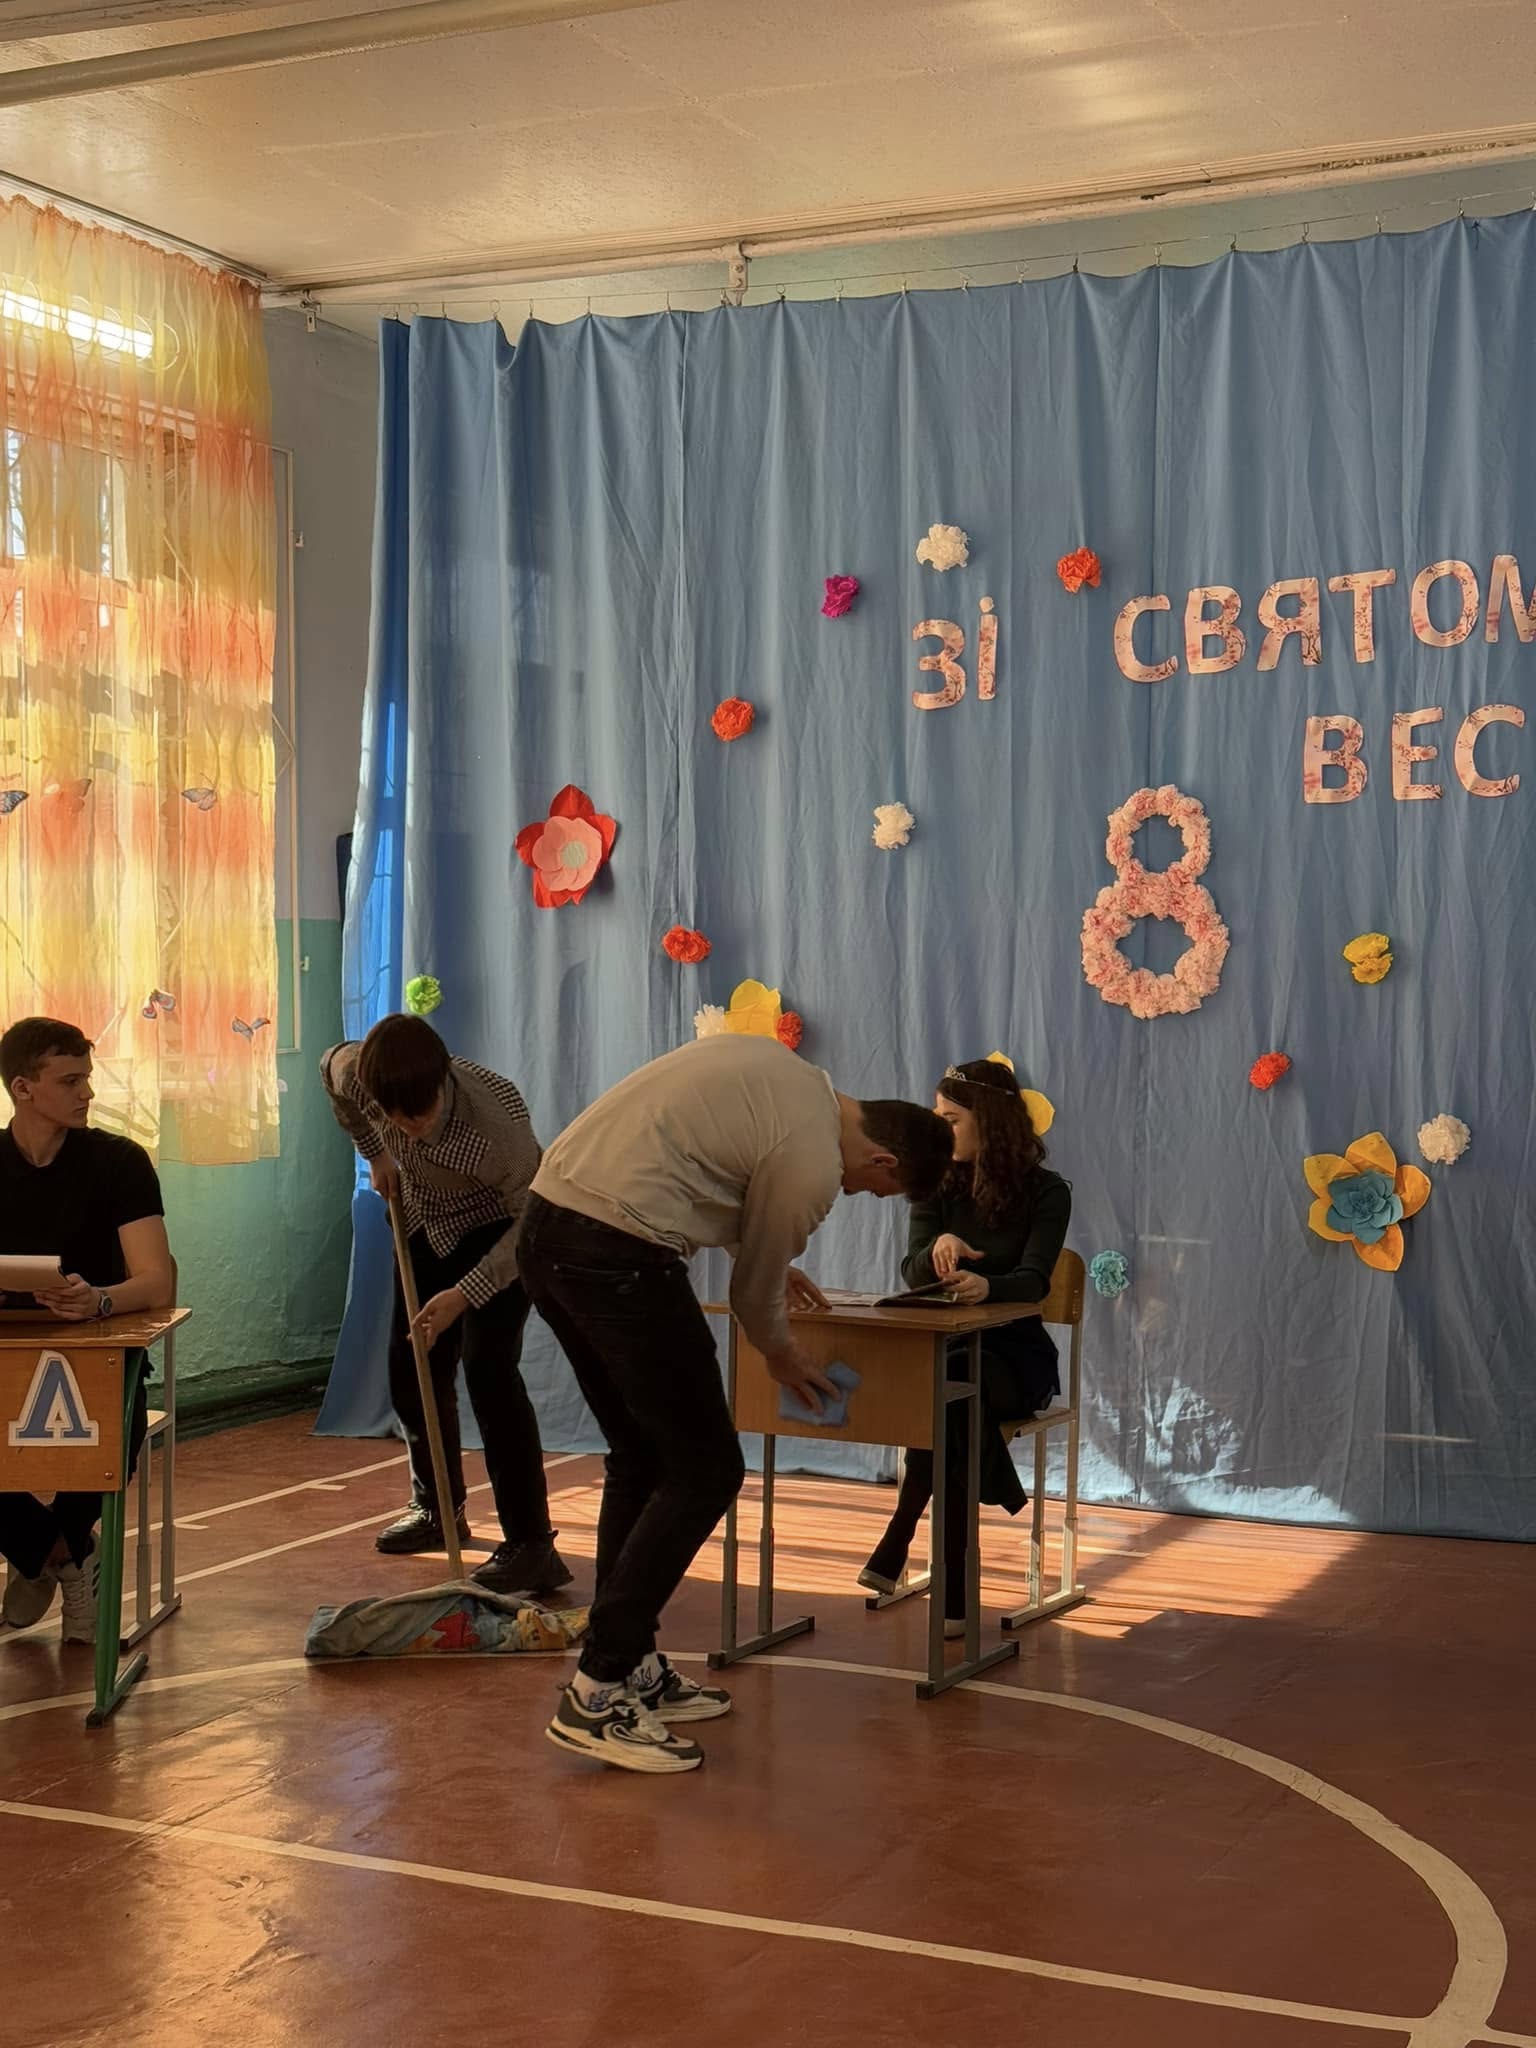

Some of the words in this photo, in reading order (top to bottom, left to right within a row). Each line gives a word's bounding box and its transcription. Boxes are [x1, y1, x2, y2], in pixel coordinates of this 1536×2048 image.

[1113, 554, 1536, 684] СВЯТОМ
[1303, 704, 1526, 804] ВЕС
[1080, 783, 1230, 1020] 8
